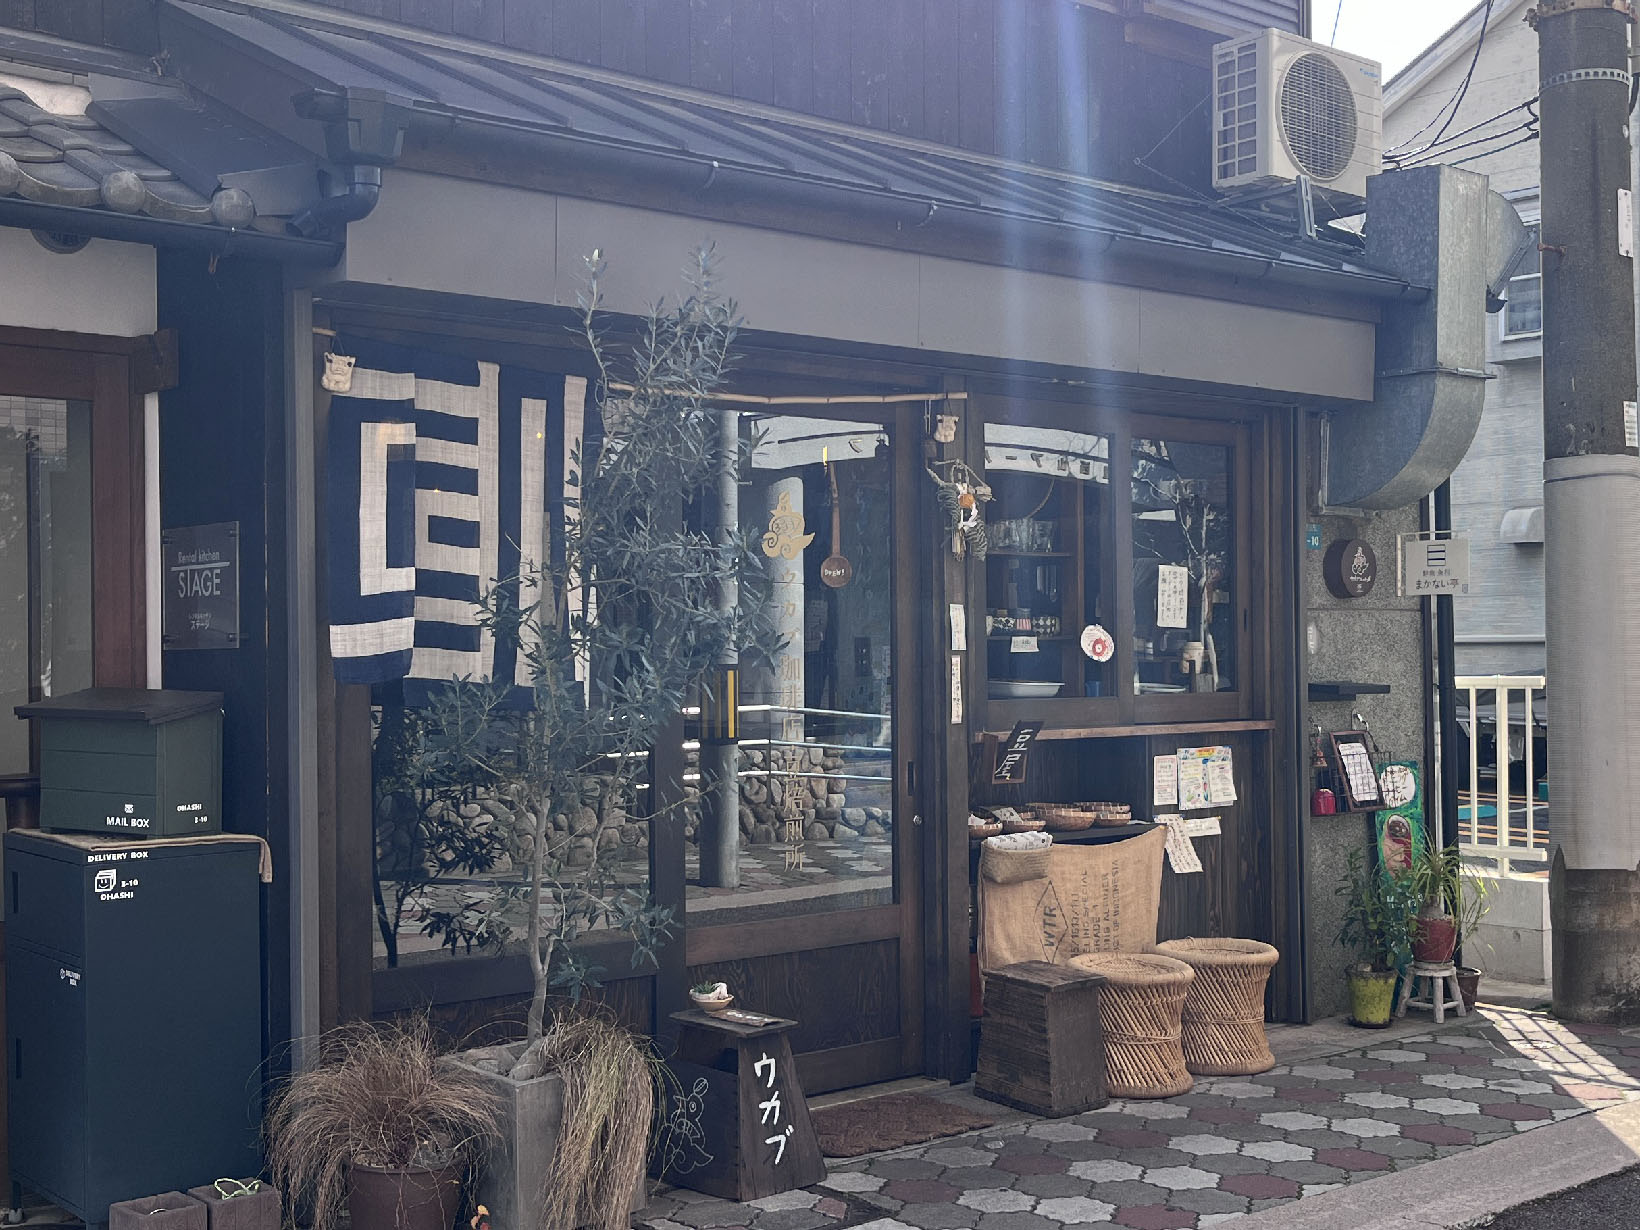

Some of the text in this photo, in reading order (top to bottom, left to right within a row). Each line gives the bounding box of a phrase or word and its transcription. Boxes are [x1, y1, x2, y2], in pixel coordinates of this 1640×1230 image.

[176, 565, 222, 598] STAGE
[106, 816, 150, 828] MAIL BOX
[87, 851, 149, 863] DELIVERY BOX
[100, 891, 134, 901] OHASHI
[1080, 869, 1090, 917] SPECIAL
[1043, 905, 1057, 947] WTR
[1093, 916, 1101, 953] GRADE
[753, 1052, 795, 1165] ウカブ
